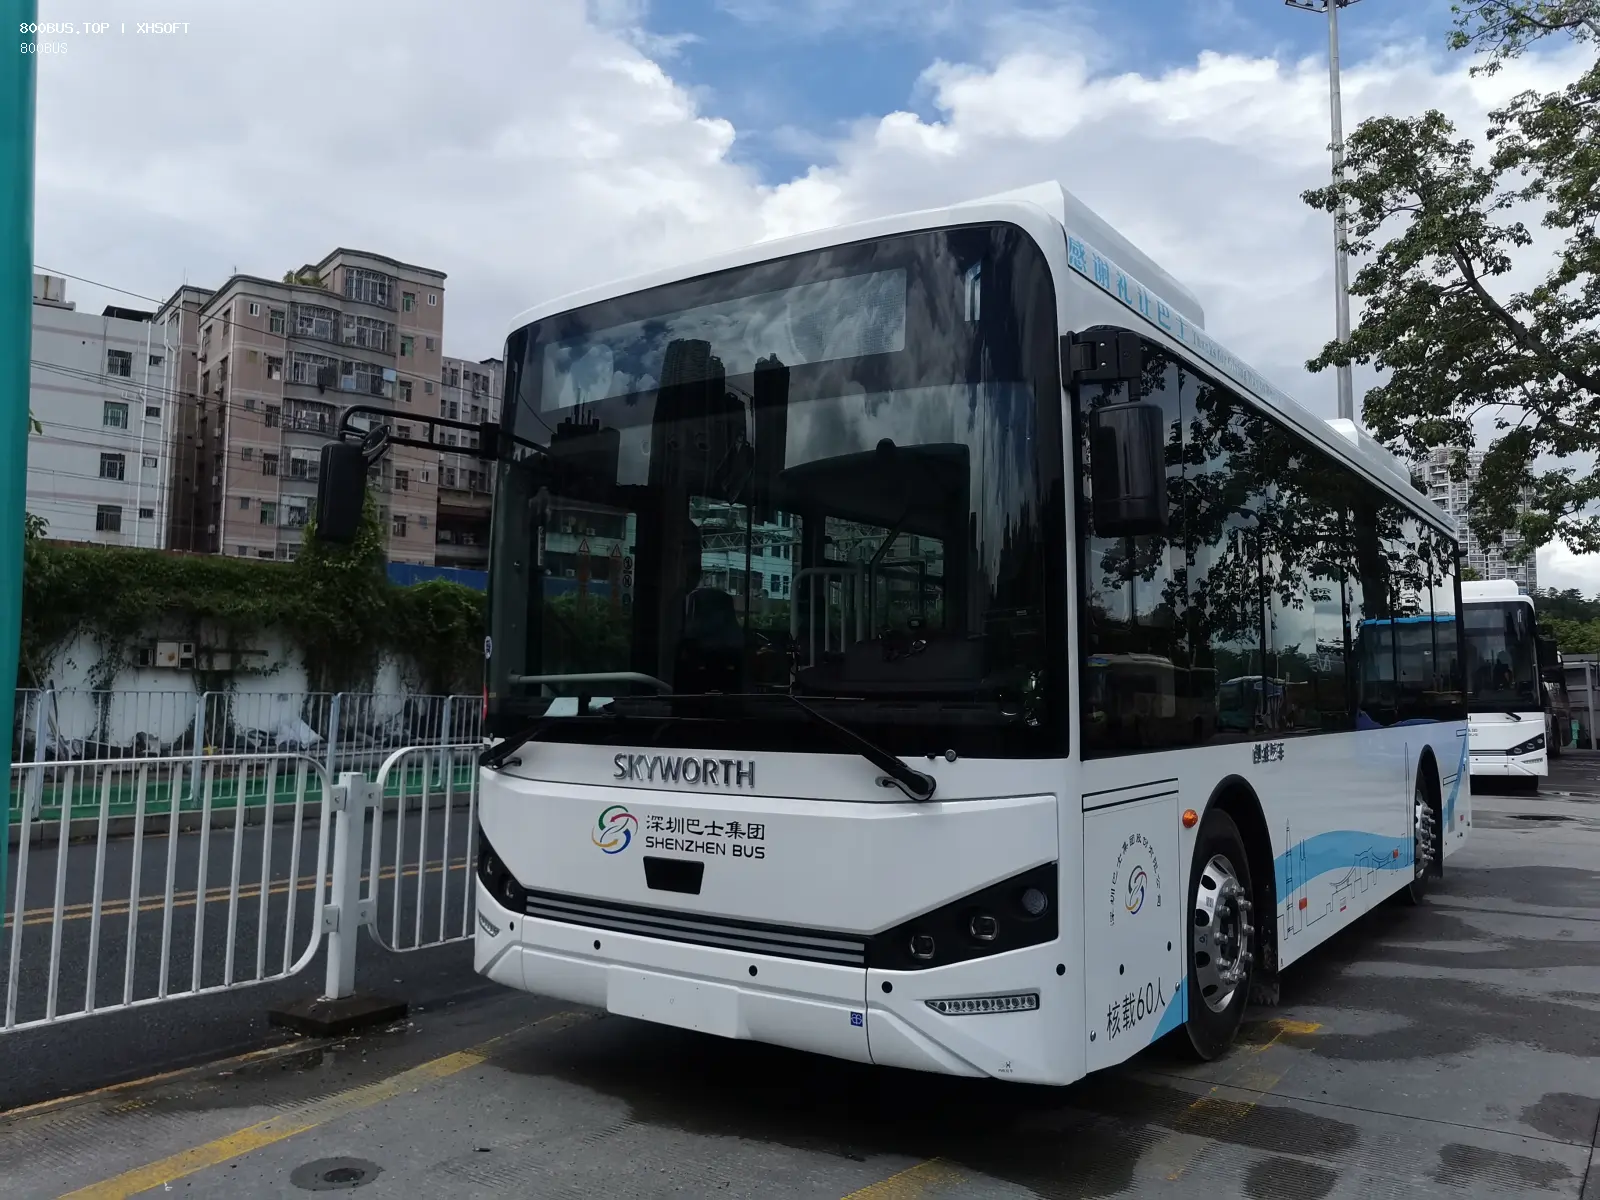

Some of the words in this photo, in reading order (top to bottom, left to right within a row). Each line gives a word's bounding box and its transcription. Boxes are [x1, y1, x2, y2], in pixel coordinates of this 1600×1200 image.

[1067, 235, 1188, 342] 感谢礼让巴士
[613, 752, 756, 788] SKYWORTH
[646, 814, 765, 840] 深圳巴士集团
[645, 836, 726, 856] SHENZHEN
[732, 844, 765, 859] BUS
[1106, 976, 1166, 1041] 核载60人
